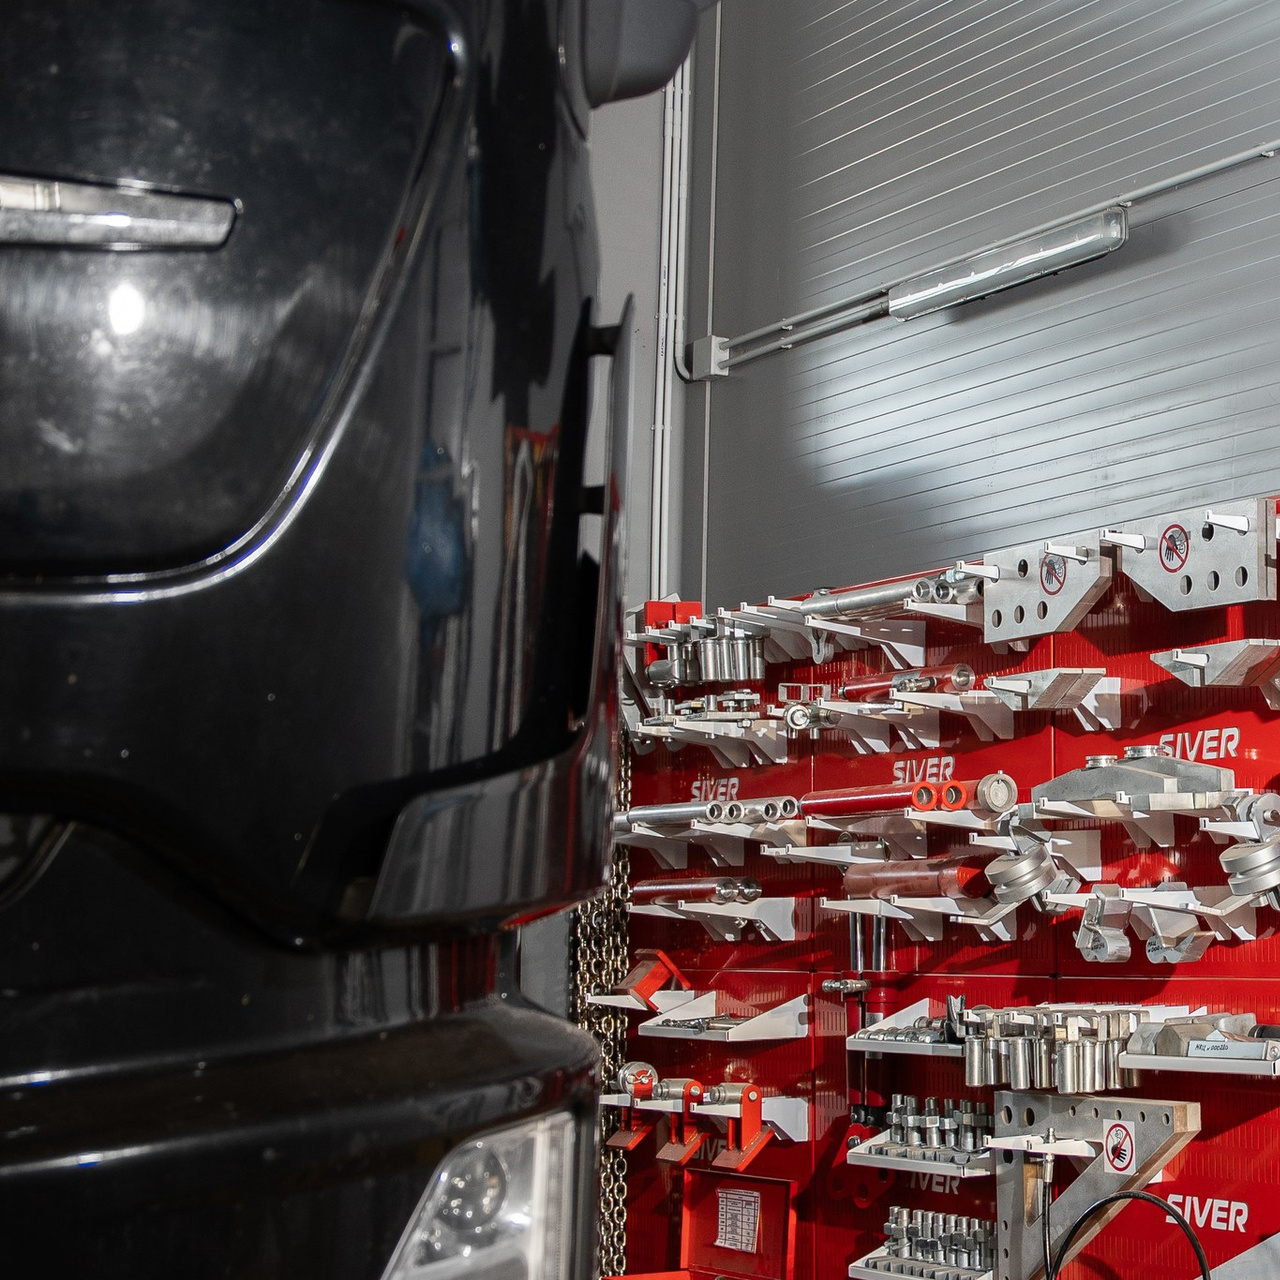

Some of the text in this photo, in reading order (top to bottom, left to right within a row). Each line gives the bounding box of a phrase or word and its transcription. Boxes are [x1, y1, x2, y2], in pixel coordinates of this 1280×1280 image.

[1159, 727, 1240, 762] SIVER
[892, 755, 955, 785] SIVER
[690, 777, 739, 802] SIVER
[909, 1171, 961, 1195] IVER
[1165, 1193, 1249, 1233] SIVER
